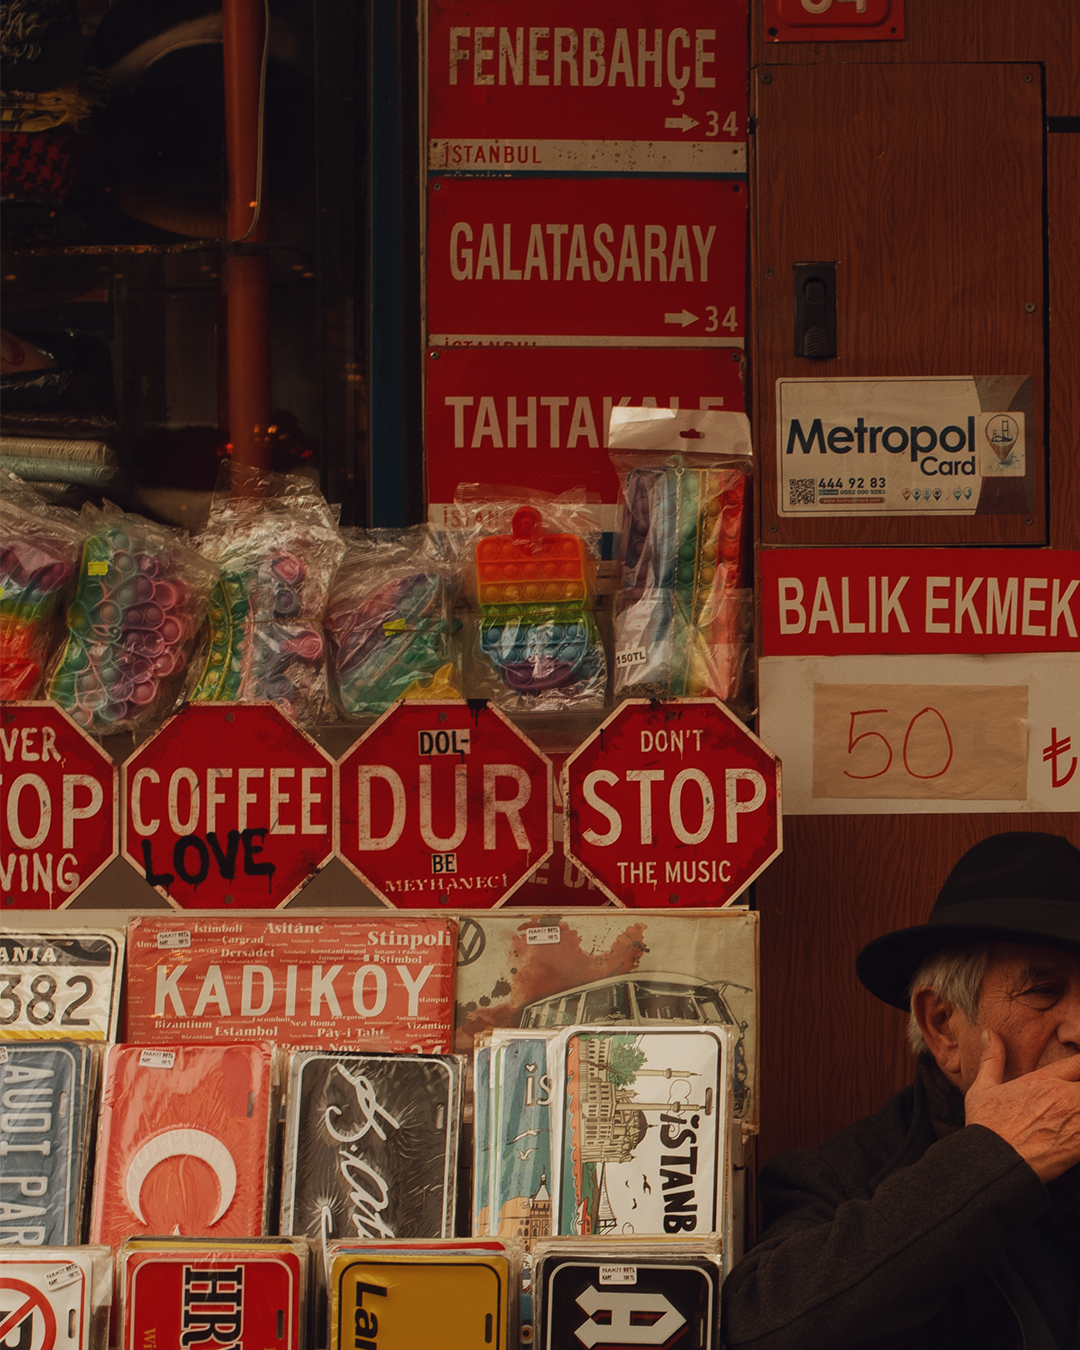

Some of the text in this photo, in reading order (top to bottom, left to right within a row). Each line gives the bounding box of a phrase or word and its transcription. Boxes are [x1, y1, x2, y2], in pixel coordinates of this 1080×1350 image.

[449, 27, 716, 106] FENERBAHÇE
[705, 110, 739, 137] 34
[444, 142, 542, 164] İSTANBUL
[450, 222, 717, 282] GALATASARAY
[705, 306, 738, 332] 34
[445, 396, 724, 448] TAHTA
[786, 416, 975, 462] Metropol
[818, 477, 886, 488] 444 92 83
[920, 456, 975, 476] Card
[778, 575, 1080, 638] BALIK EKMEK
[616, 651, 645, 664] 150TL
[418, 731, 470, 755] DOL-
[640, 729, 704, 753] DON'T
[844, 707, 953, 779] 50
[0, 773, 104, 850] OP
[131, 766, 328, 836] COFFEE
[358, 763, 532, 852] DUR
[582, 767, 767, 847] STOP
[141, 828, 276, 892] LOVE
[431, 854, 456, 873] BE
[617, 861, 658, 885] THE
[665, 859, 732, 884] MUSIC
[367, 930, 452, 950] Stinpoli
[0, 974, 94, 1026] 382
[154, 954, 435, 1017] KADIKÖY
[215, 1026, 279, 1036] Estambol
[310, 1019, 336, 1027] Roma
[0, 1065, 55, 1157] AUDI
